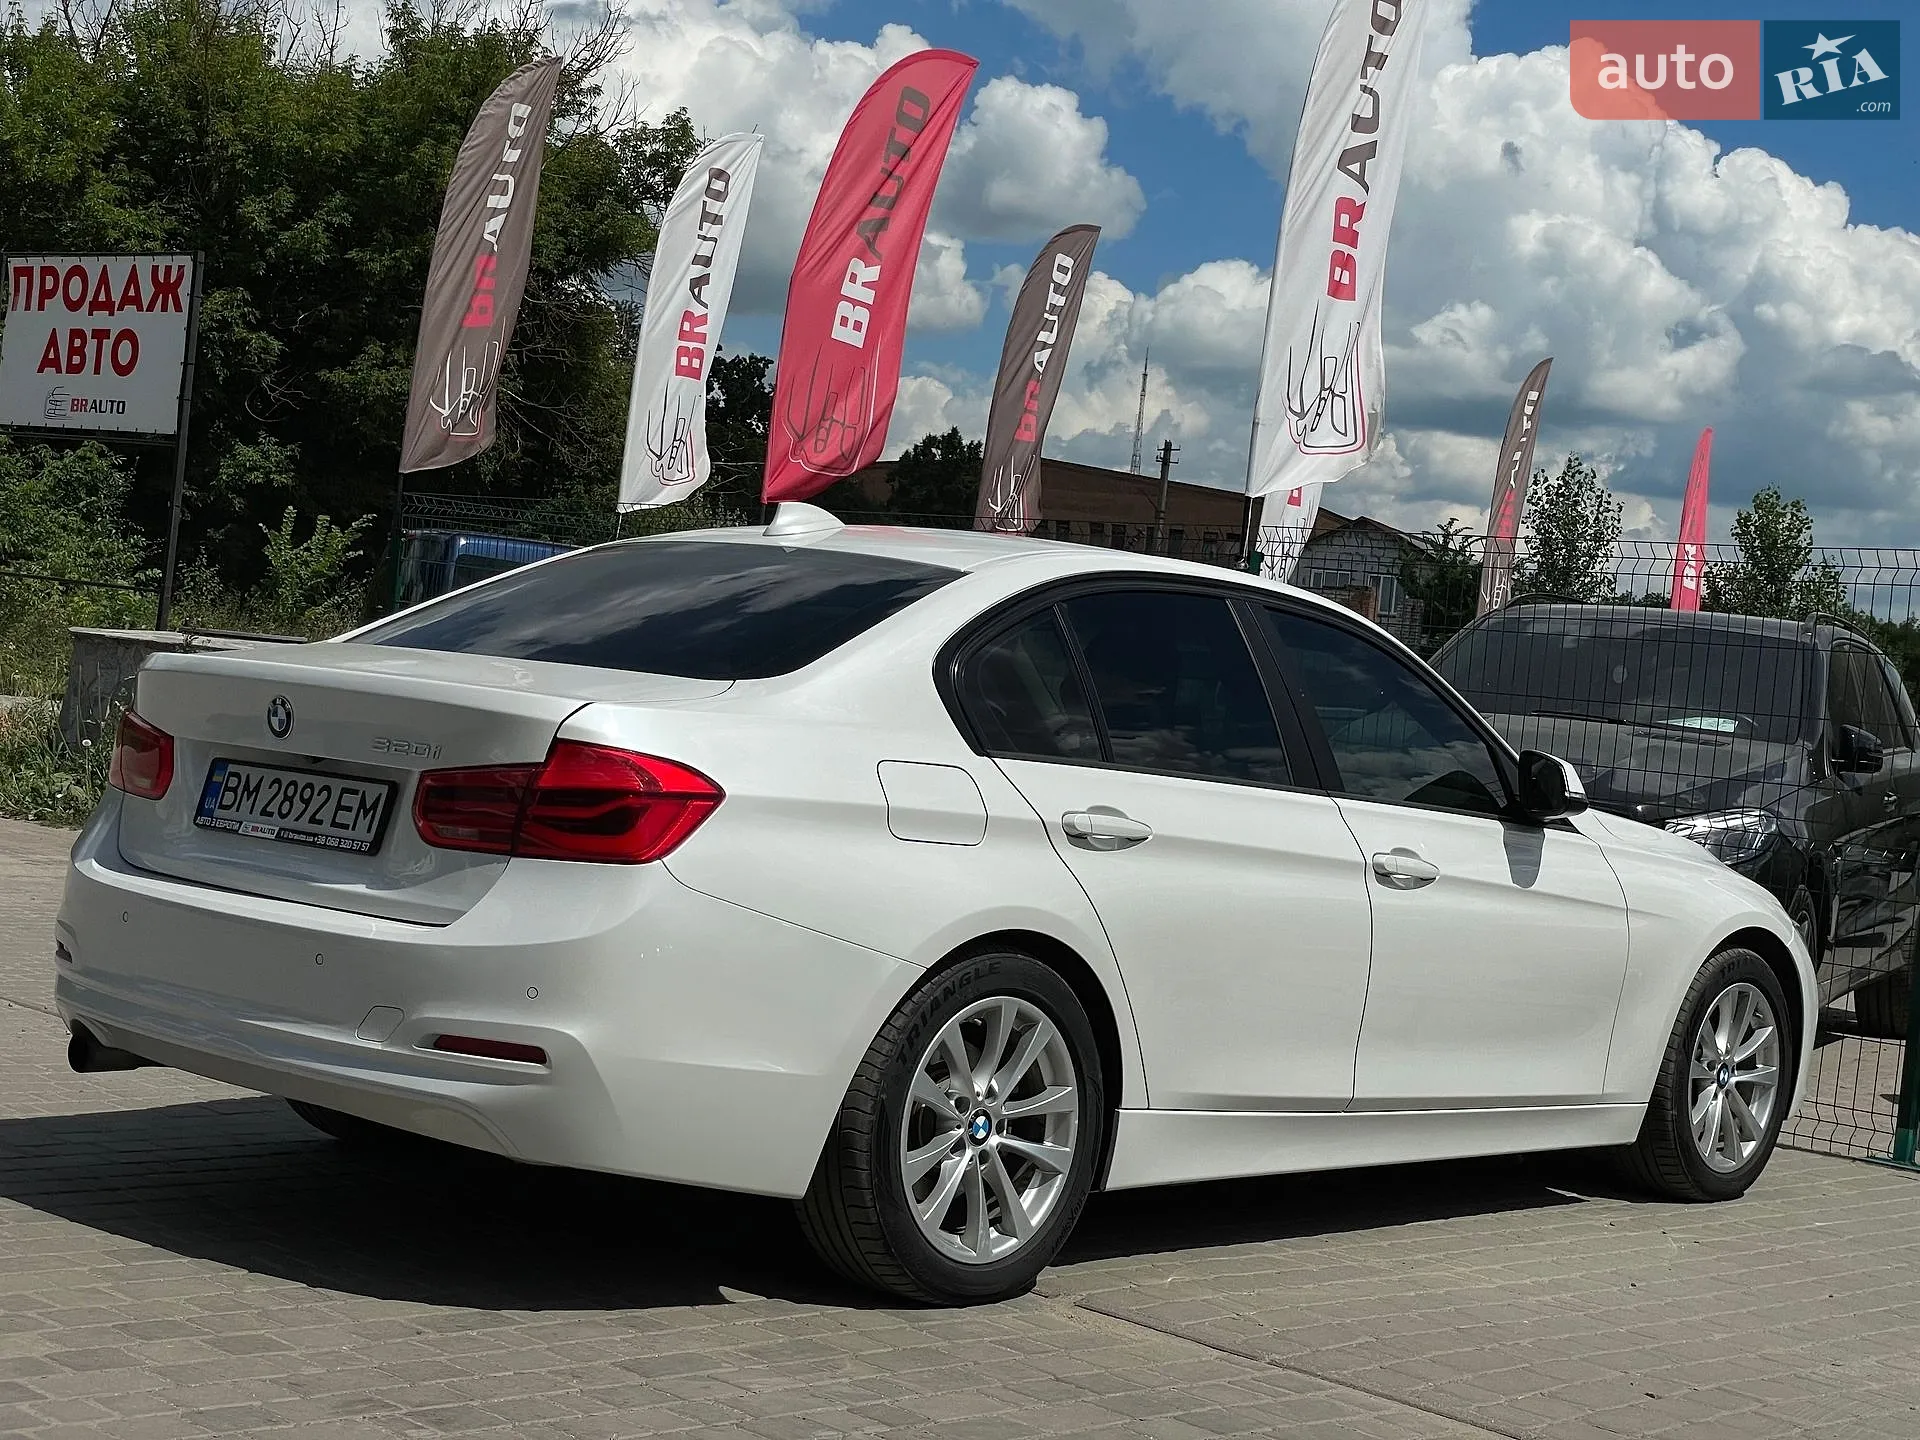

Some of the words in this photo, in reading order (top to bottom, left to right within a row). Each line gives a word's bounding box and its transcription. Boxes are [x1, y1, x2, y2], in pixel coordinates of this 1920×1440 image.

[1326, 0, 1403, 301] BRAUTO
[831, 85, 931, 349] BRAUTO
[11, 263, 186, 317] ПРОДАЖ
[674, 166, 731, 381] BRAUTO
[36, 327, 140, 377] АВТО
[70, 397, 126, 415] BRAUTO
[371, 736, 443, 761] 320i
[204, 797, 216, 810] UA
[217, 771, 265, 815] BM
[259, 777, 332, 826] 2892
[330, 786, 383, 834] EM
[896, 960, 1003, 1065] TRIANGLE
